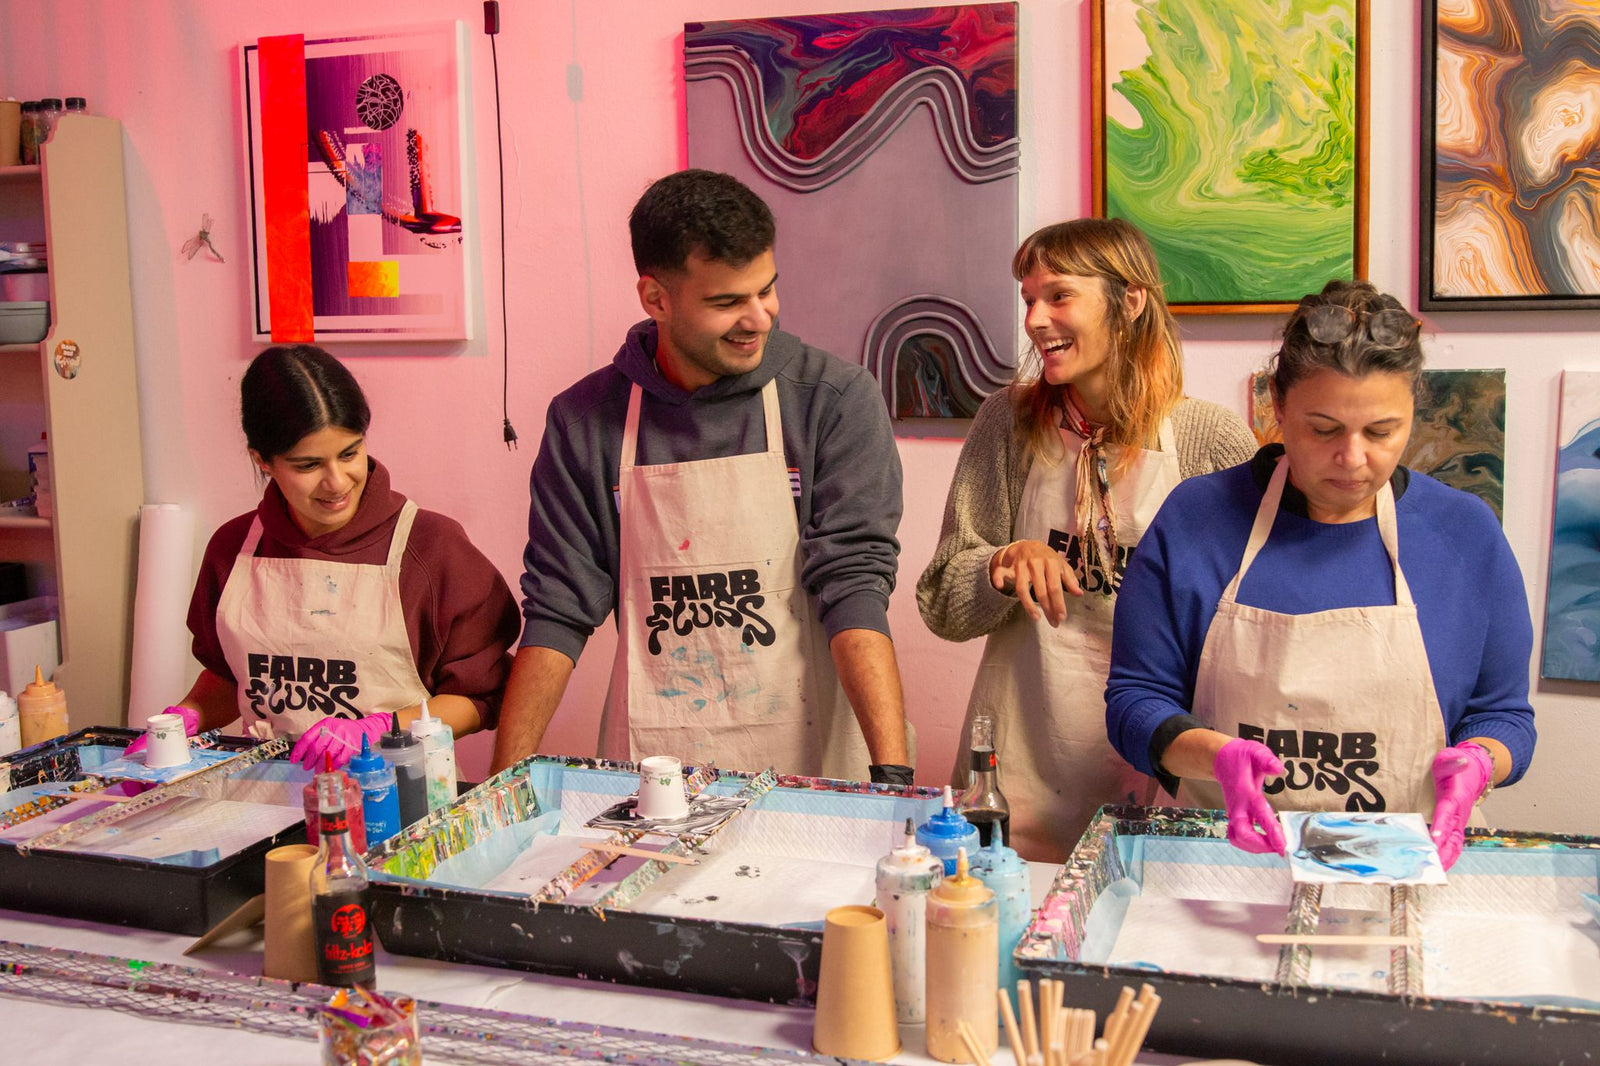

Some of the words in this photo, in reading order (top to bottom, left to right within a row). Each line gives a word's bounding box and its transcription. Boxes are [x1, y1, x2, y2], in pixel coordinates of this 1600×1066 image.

[650, 569, 760, 603] FARB
[646, 595, 776, 656] FLUSS
[248, 653, 357, 687] FARB
[1264, 760, 1386, 812] USS
[325, 938, 373, 961] fritz-kola
